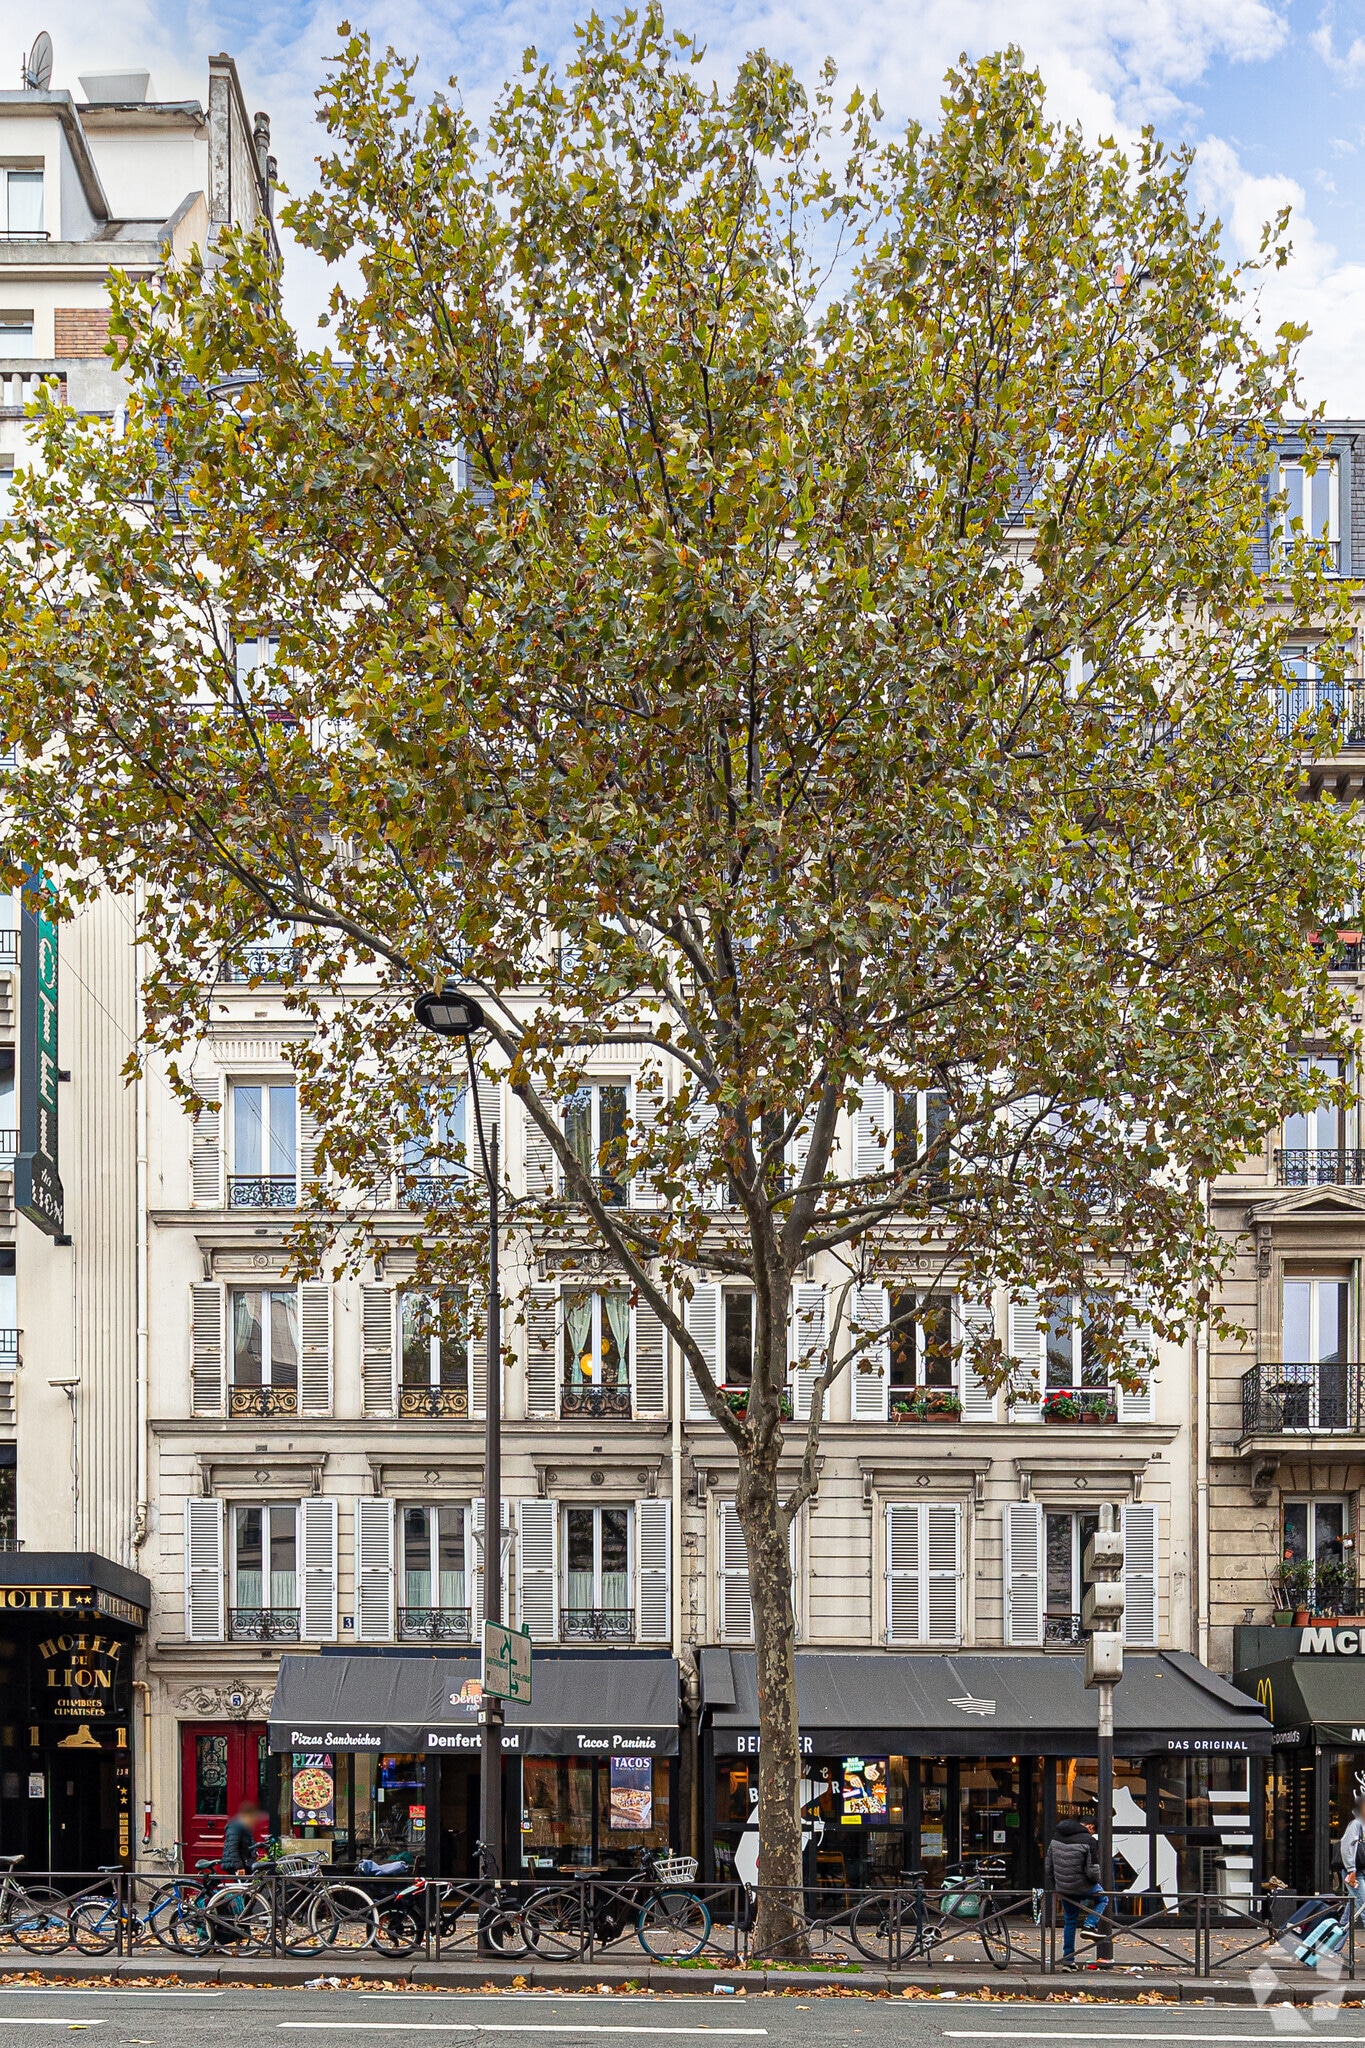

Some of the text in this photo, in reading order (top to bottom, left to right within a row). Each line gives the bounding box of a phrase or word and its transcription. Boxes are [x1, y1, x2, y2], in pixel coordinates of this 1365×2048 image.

[345, 1617, 352, 1628] 3
[38, 1633, 122, 1661] HOTEL
[71, 1655, 88, 1666] DU
[47, 1668, 112, 1688] LION
[57, 1699, 103, 1707] CHAMBRES
[115, 1727, 128, 1748] 1
[291, 1731, 382, 1746] Pizzas Sandwiches
[428, 1733, 482, 1747] Denfert
[576, 1734, 657, 1749] Tacos Paninis
[1167, 1740, 1249, 1750] DAS ORIGINAL
[292, 1753, 334, 1768] PIZZA
[614, 1757, 651, 1768] TACOS
